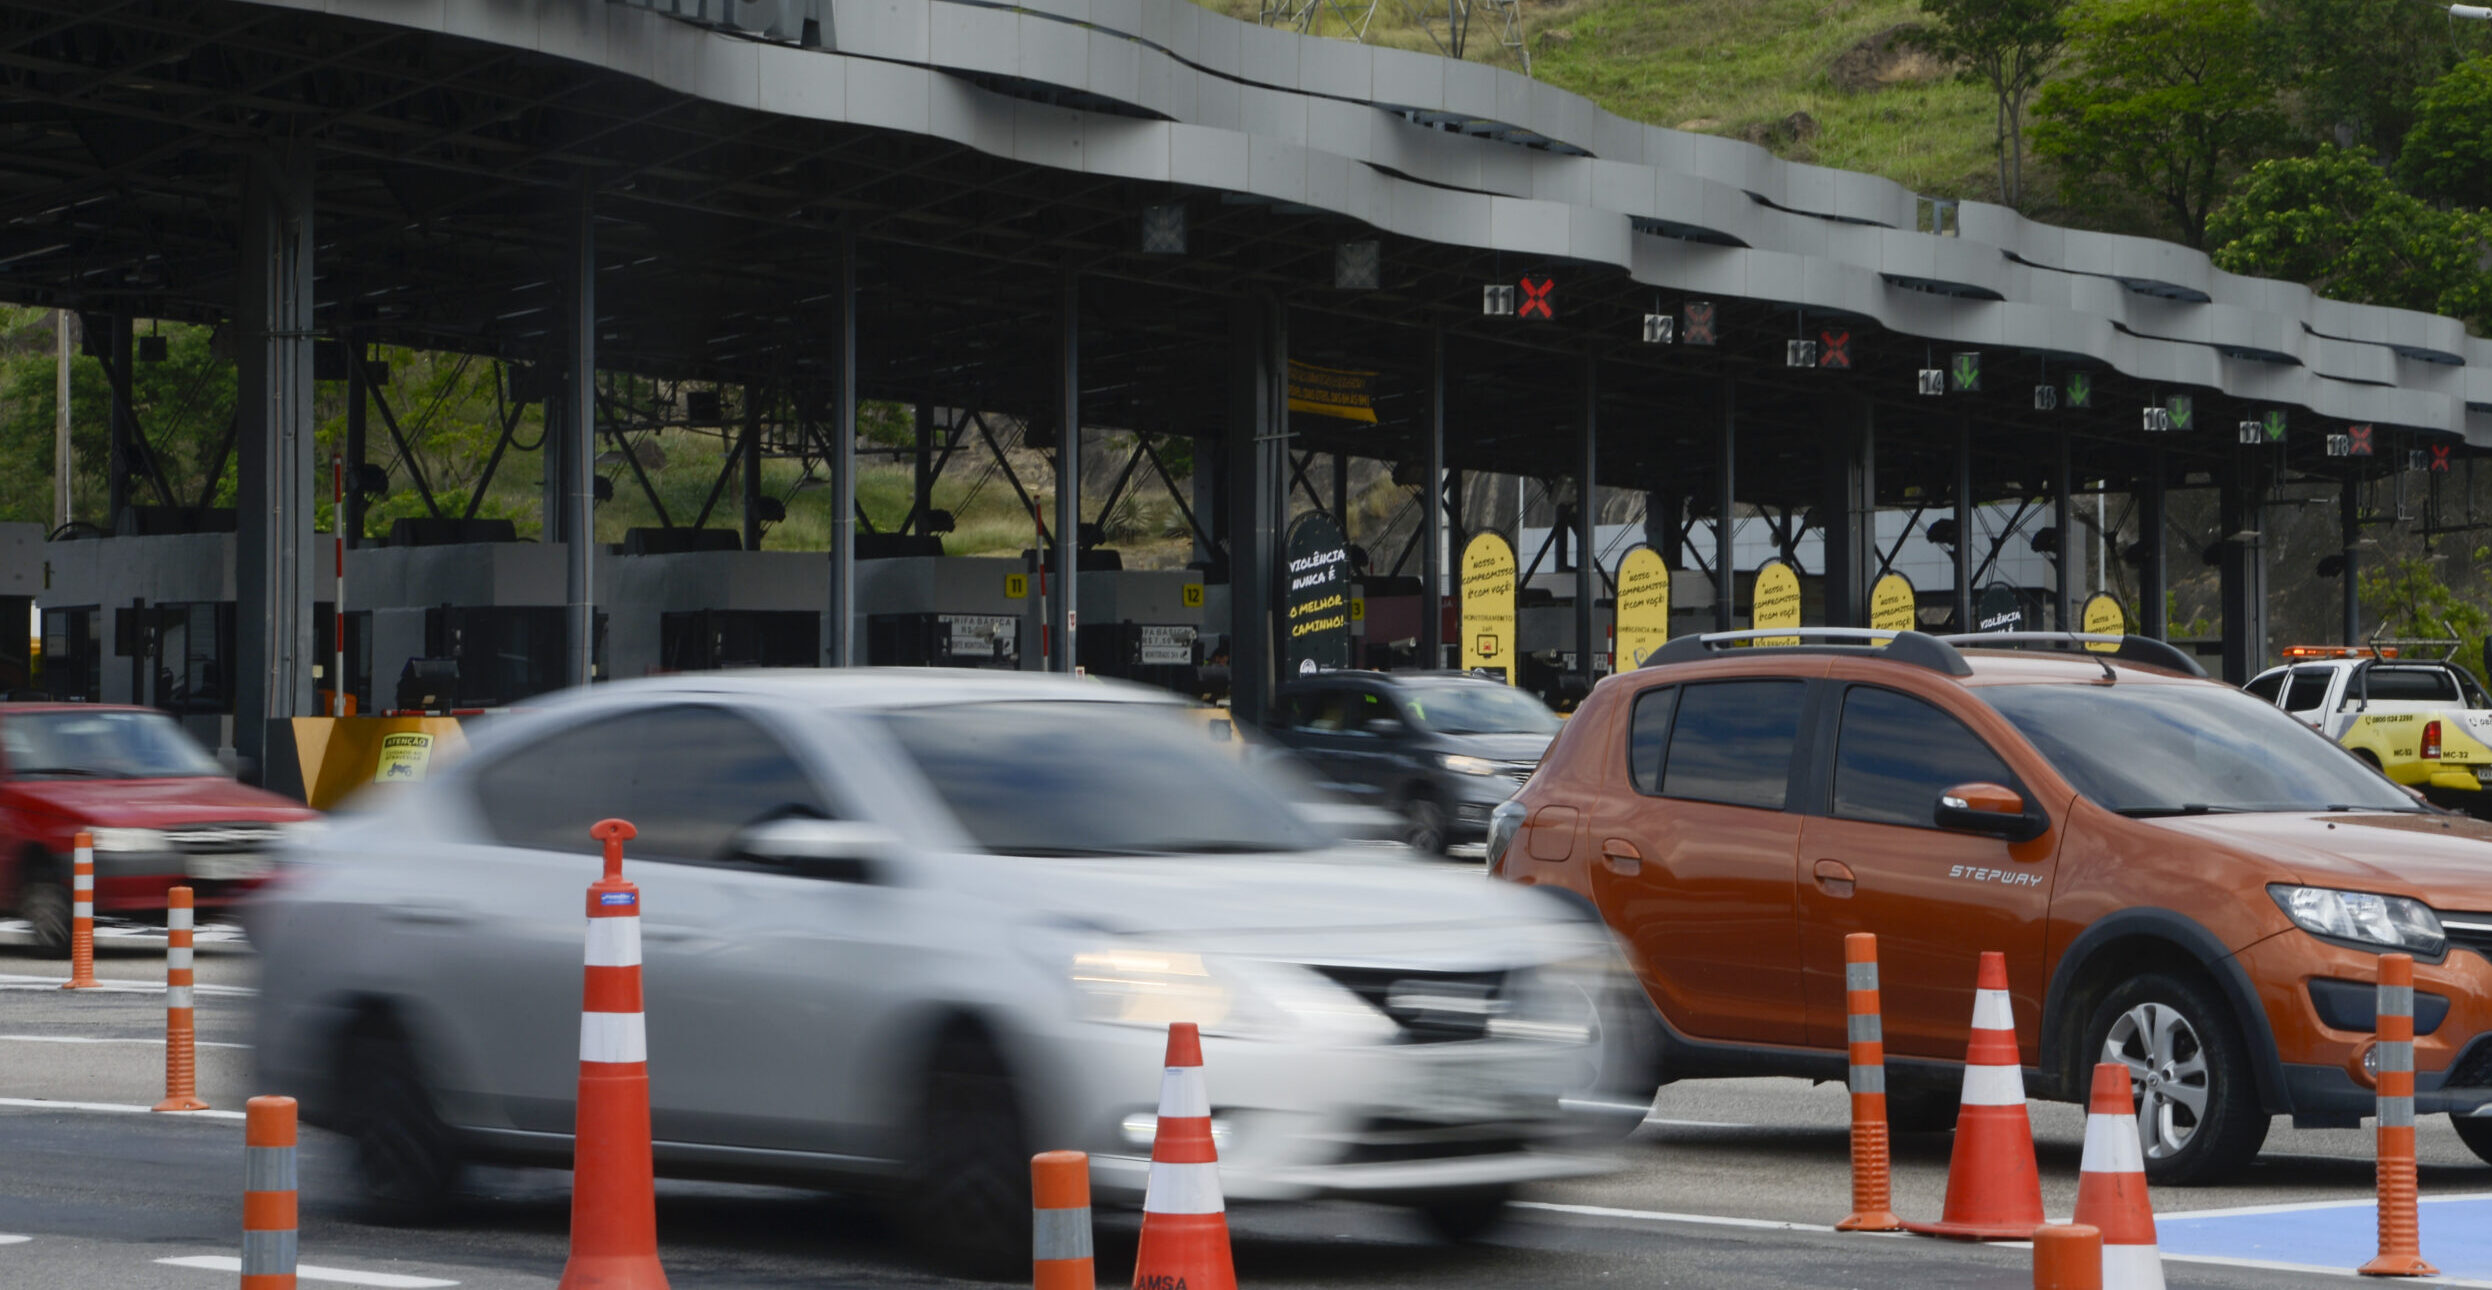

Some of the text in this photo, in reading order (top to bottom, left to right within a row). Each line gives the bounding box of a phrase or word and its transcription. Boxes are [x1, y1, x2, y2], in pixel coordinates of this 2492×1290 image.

[1486, 286, 1514, 313] 11
[1646, 316, 1674, 343] 12
[1919, 370, 1944, 394] 14
[2145, 408, 2168, 430] 16
[2241, 422, 2261, 443] 17
[2328, 435, 2349, 456] 18
[1289, 548, 1345, 573] VIOLÊNCIA
[1473, 557, 1496, 569] NOSSO
[1292, 565, 1336, 591] NUNCA É
[1462, 566, 1514, 585] COMPROMISSO
[1629, 571, 1650, 582] NOSSO
[1011, 578, 1022, 593] 11
[1187, 588, 1200, 602] 12
[1474, 587, 1490, 598] COM
[1618, 580, 1667, 597] COMPROMISSO
[1764, 585, 1784, 594] NOSSO
[1289, 594, 1343, 619] O MELHOR
[1353, 603, 1360, 615] 3
[1629, 599, 1644, 609] COM
[1754, 593, 1800, 609] COMPROMISSO
[1291, 615, 1344, 637] CAMINHO!
[1980, 611, 2021, 630] VIOLÊNCIA
[387, 737, 426, 747] ATENÇÃO
[2443, 751, 2469, 759] MC-32
[1948, 864, 2044, 888] STEPWAY
